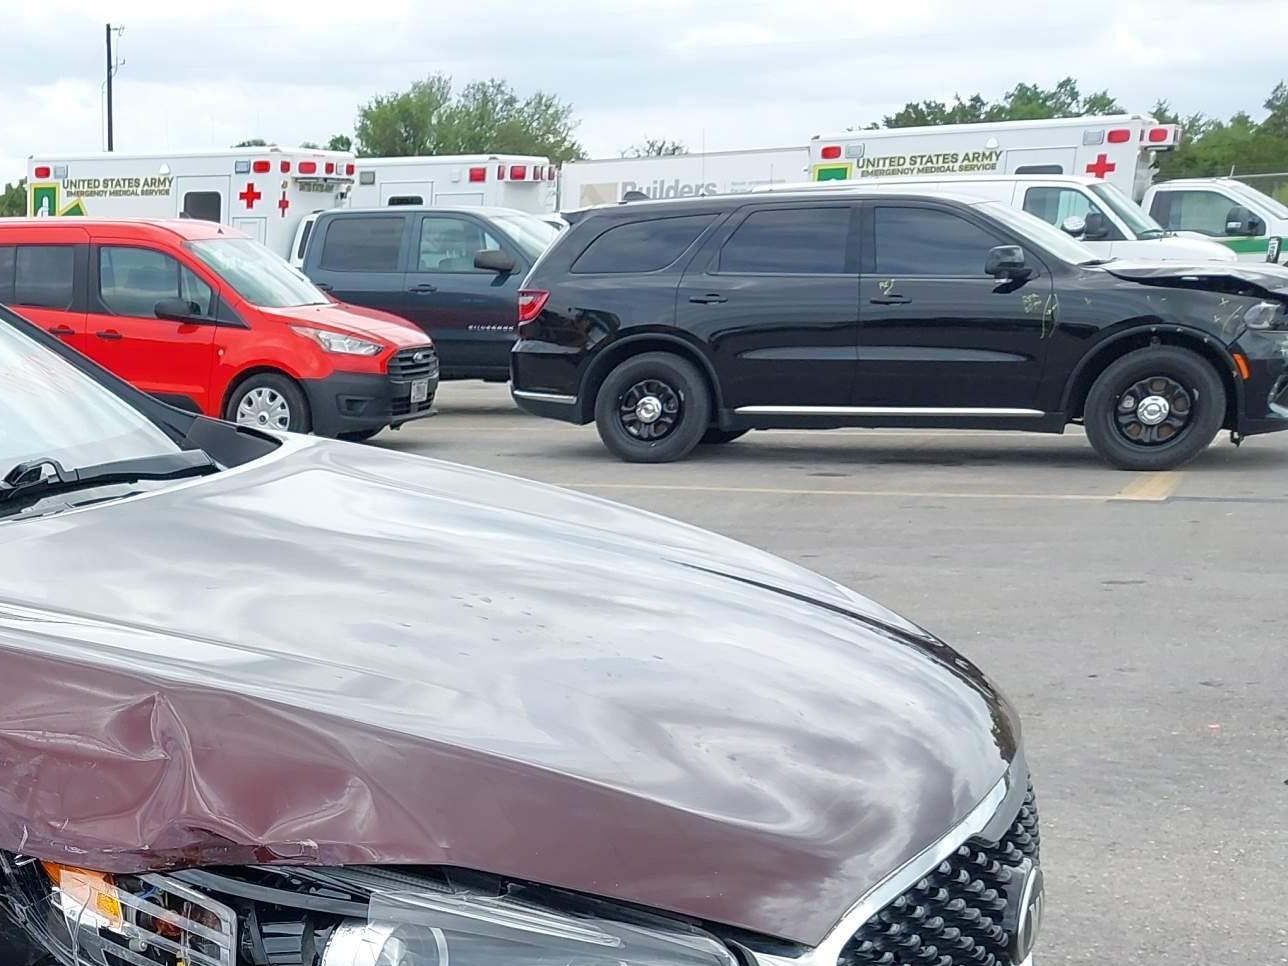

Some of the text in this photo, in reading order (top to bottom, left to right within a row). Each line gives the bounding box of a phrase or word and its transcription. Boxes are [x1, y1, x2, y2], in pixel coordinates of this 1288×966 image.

[856, 151, 1003, 169] UNITED STATES ARMY
[861, 163, 997, 178] EMERGENCY MEDICAL SERVICE
[62, 176, 174, 189] UNITED STATES ARMY
[66, 188, 170, 198] EMERGENCY MEDICAL SERVICE
